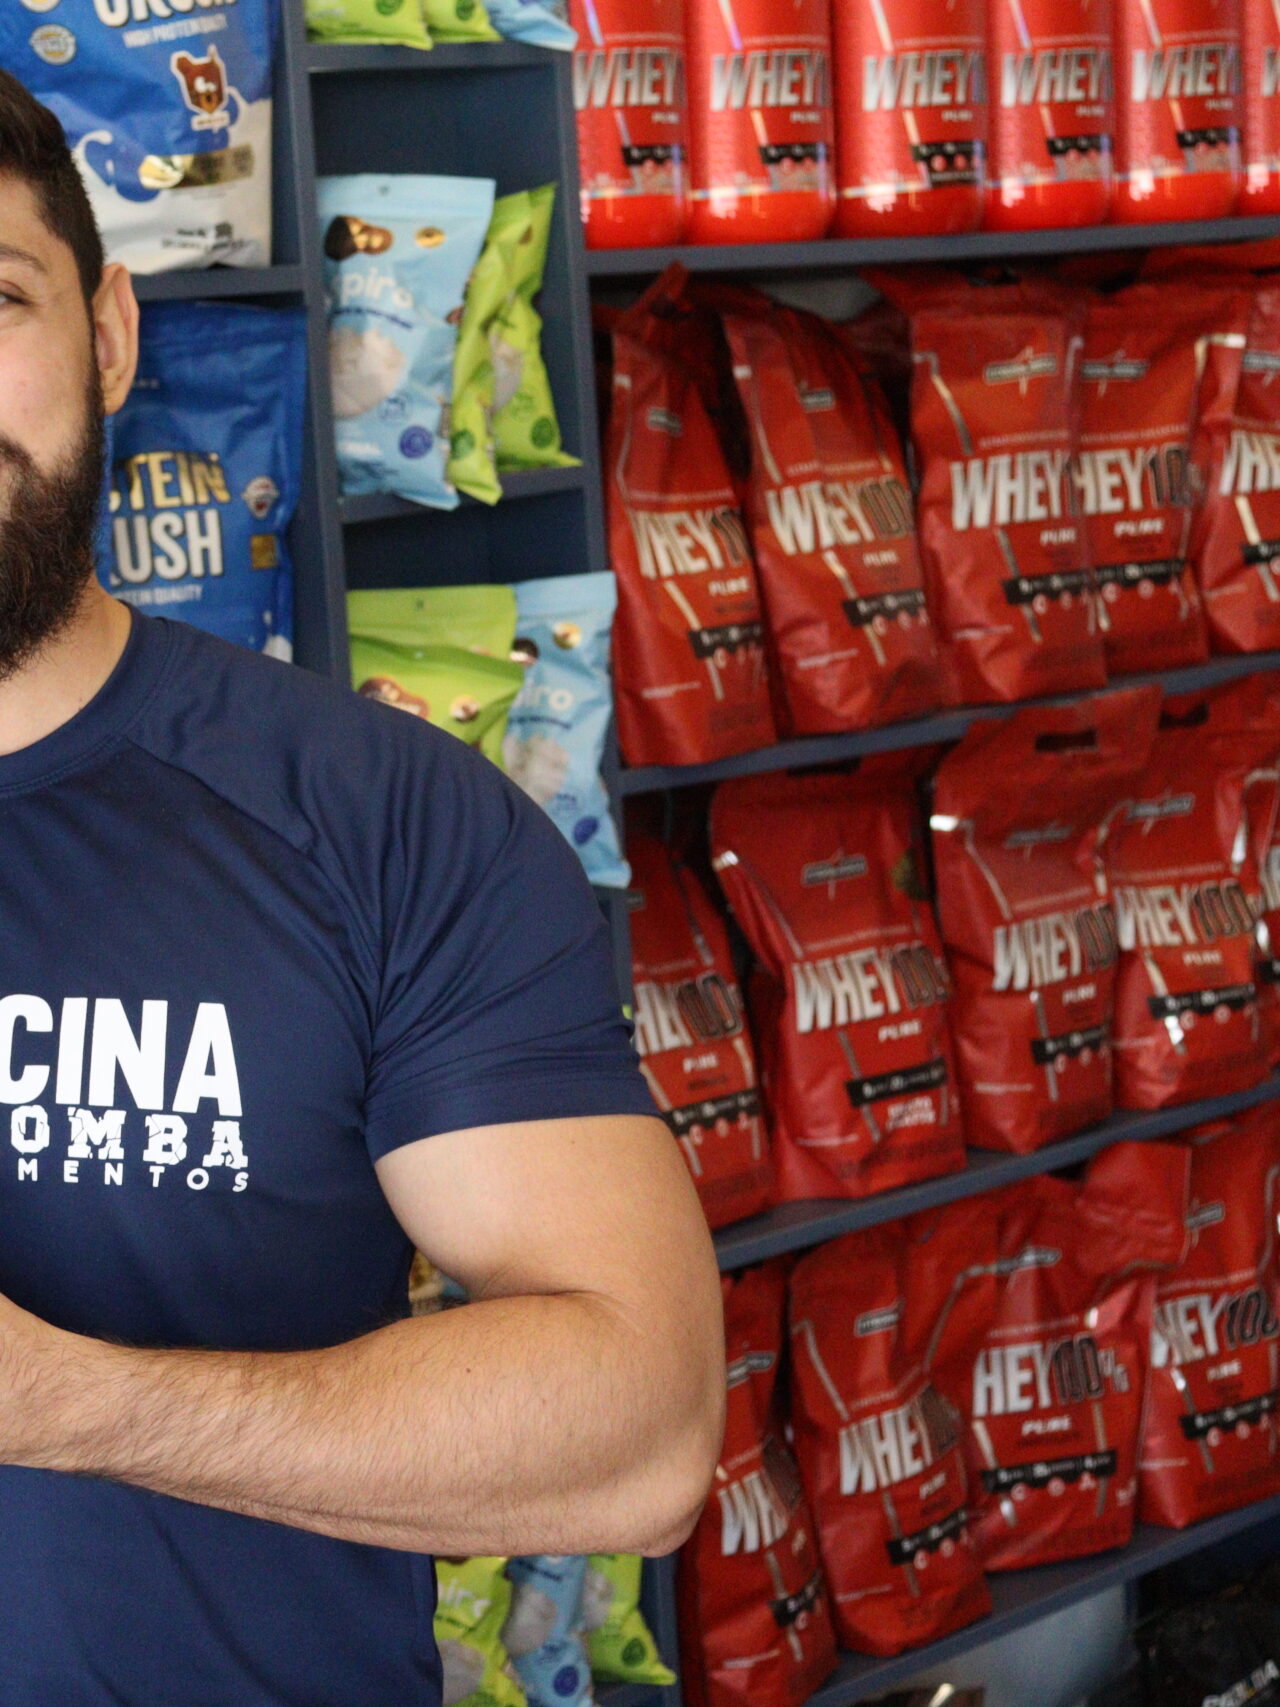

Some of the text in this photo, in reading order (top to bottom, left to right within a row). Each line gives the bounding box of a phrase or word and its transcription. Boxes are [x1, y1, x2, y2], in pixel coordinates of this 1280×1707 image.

[109, 450, 231, 513] TEIN
[1076, 447, 1148, 516] HEY
[110, 508, 223, 587] USH
[973, 1342, 1054, 1418] HEY
